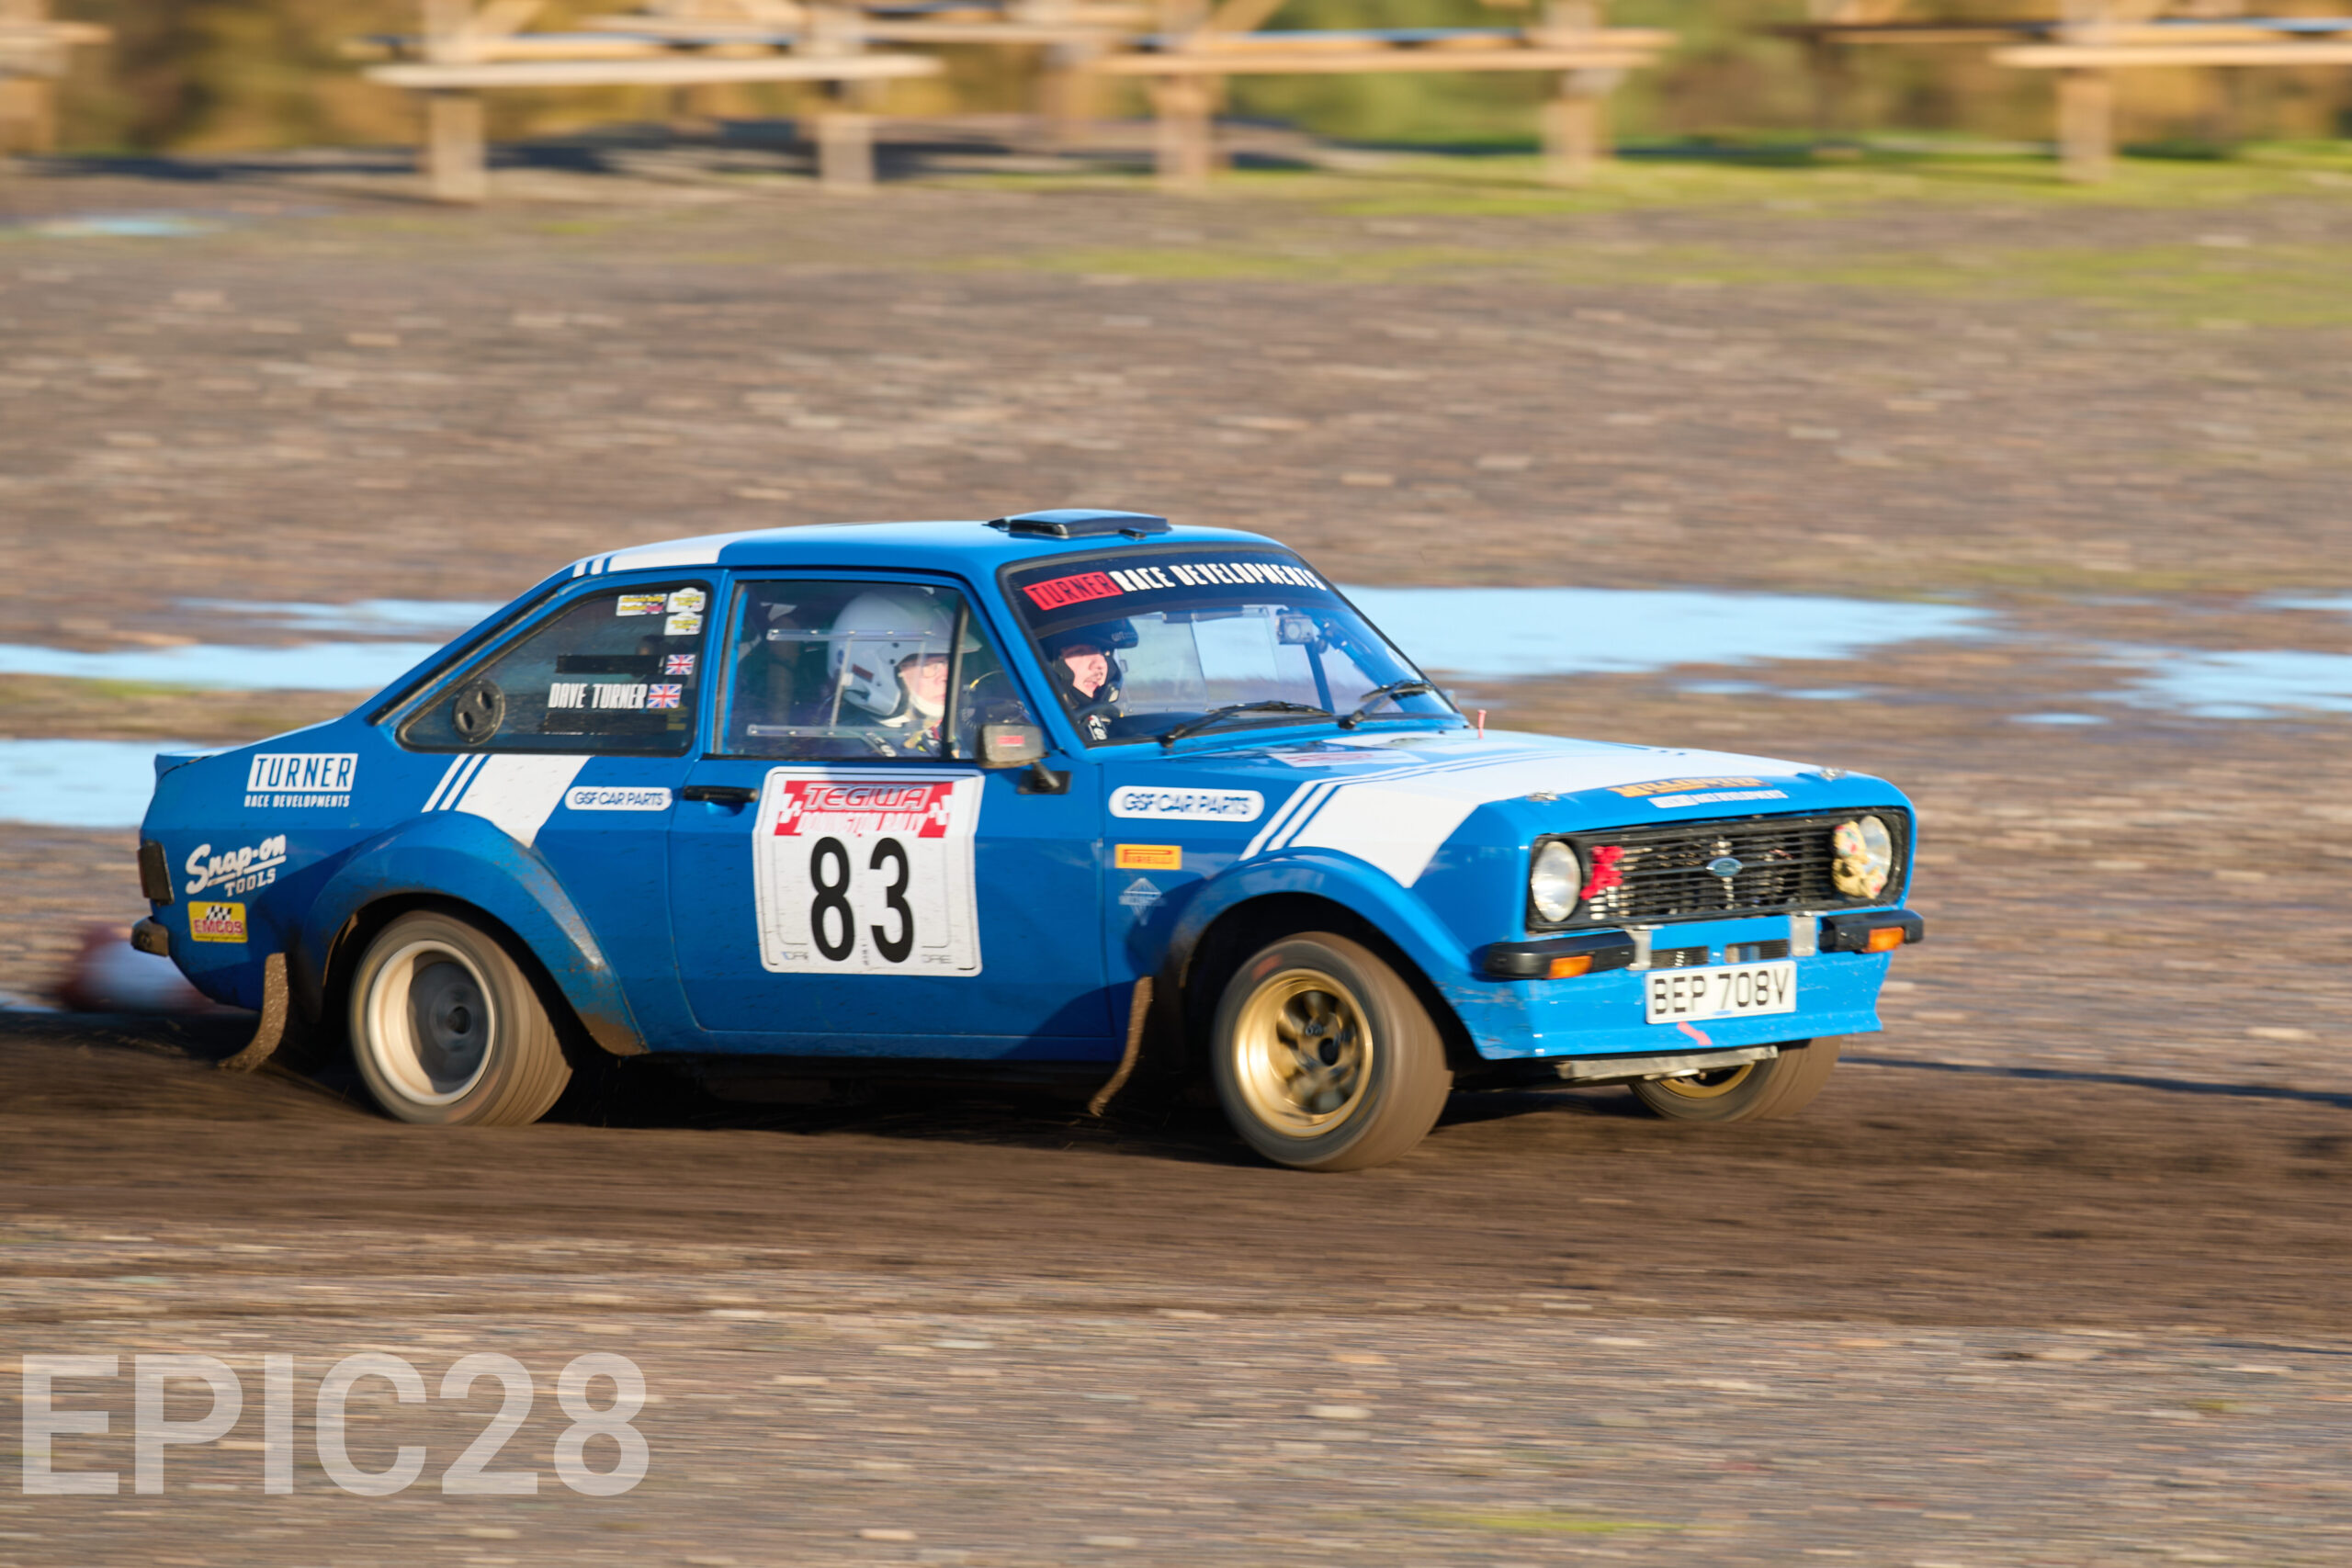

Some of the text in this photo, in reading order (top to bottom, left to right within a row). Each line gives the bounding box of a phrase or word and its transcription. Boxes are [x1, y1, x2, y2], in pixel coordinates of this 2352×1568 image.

[1025, 562, 1328, 606] TURNER RACE DEVELOPMENTS
[548, 683, 648, 709] DAVE TURNER
[254, 758, 352, 787] TURNER
[244, 795, 351, 807] RACE DEVELOPMENTS
[574, 792, 663, 807] GSF CAR PARTS
[804, 783, 933, 810] TEGIWA
[1158, 794, 1193, 813] CAR
[1199, 795, 1250, 815] PARTS
[186, 834, 287, 895] Snap-on
[224, 868, 276, 897] TOOLS
[810, 837, 914, 963] 83
[194, 919, 243, 934] EMCOS
[1717, 970, 1792, 1010] 708V
